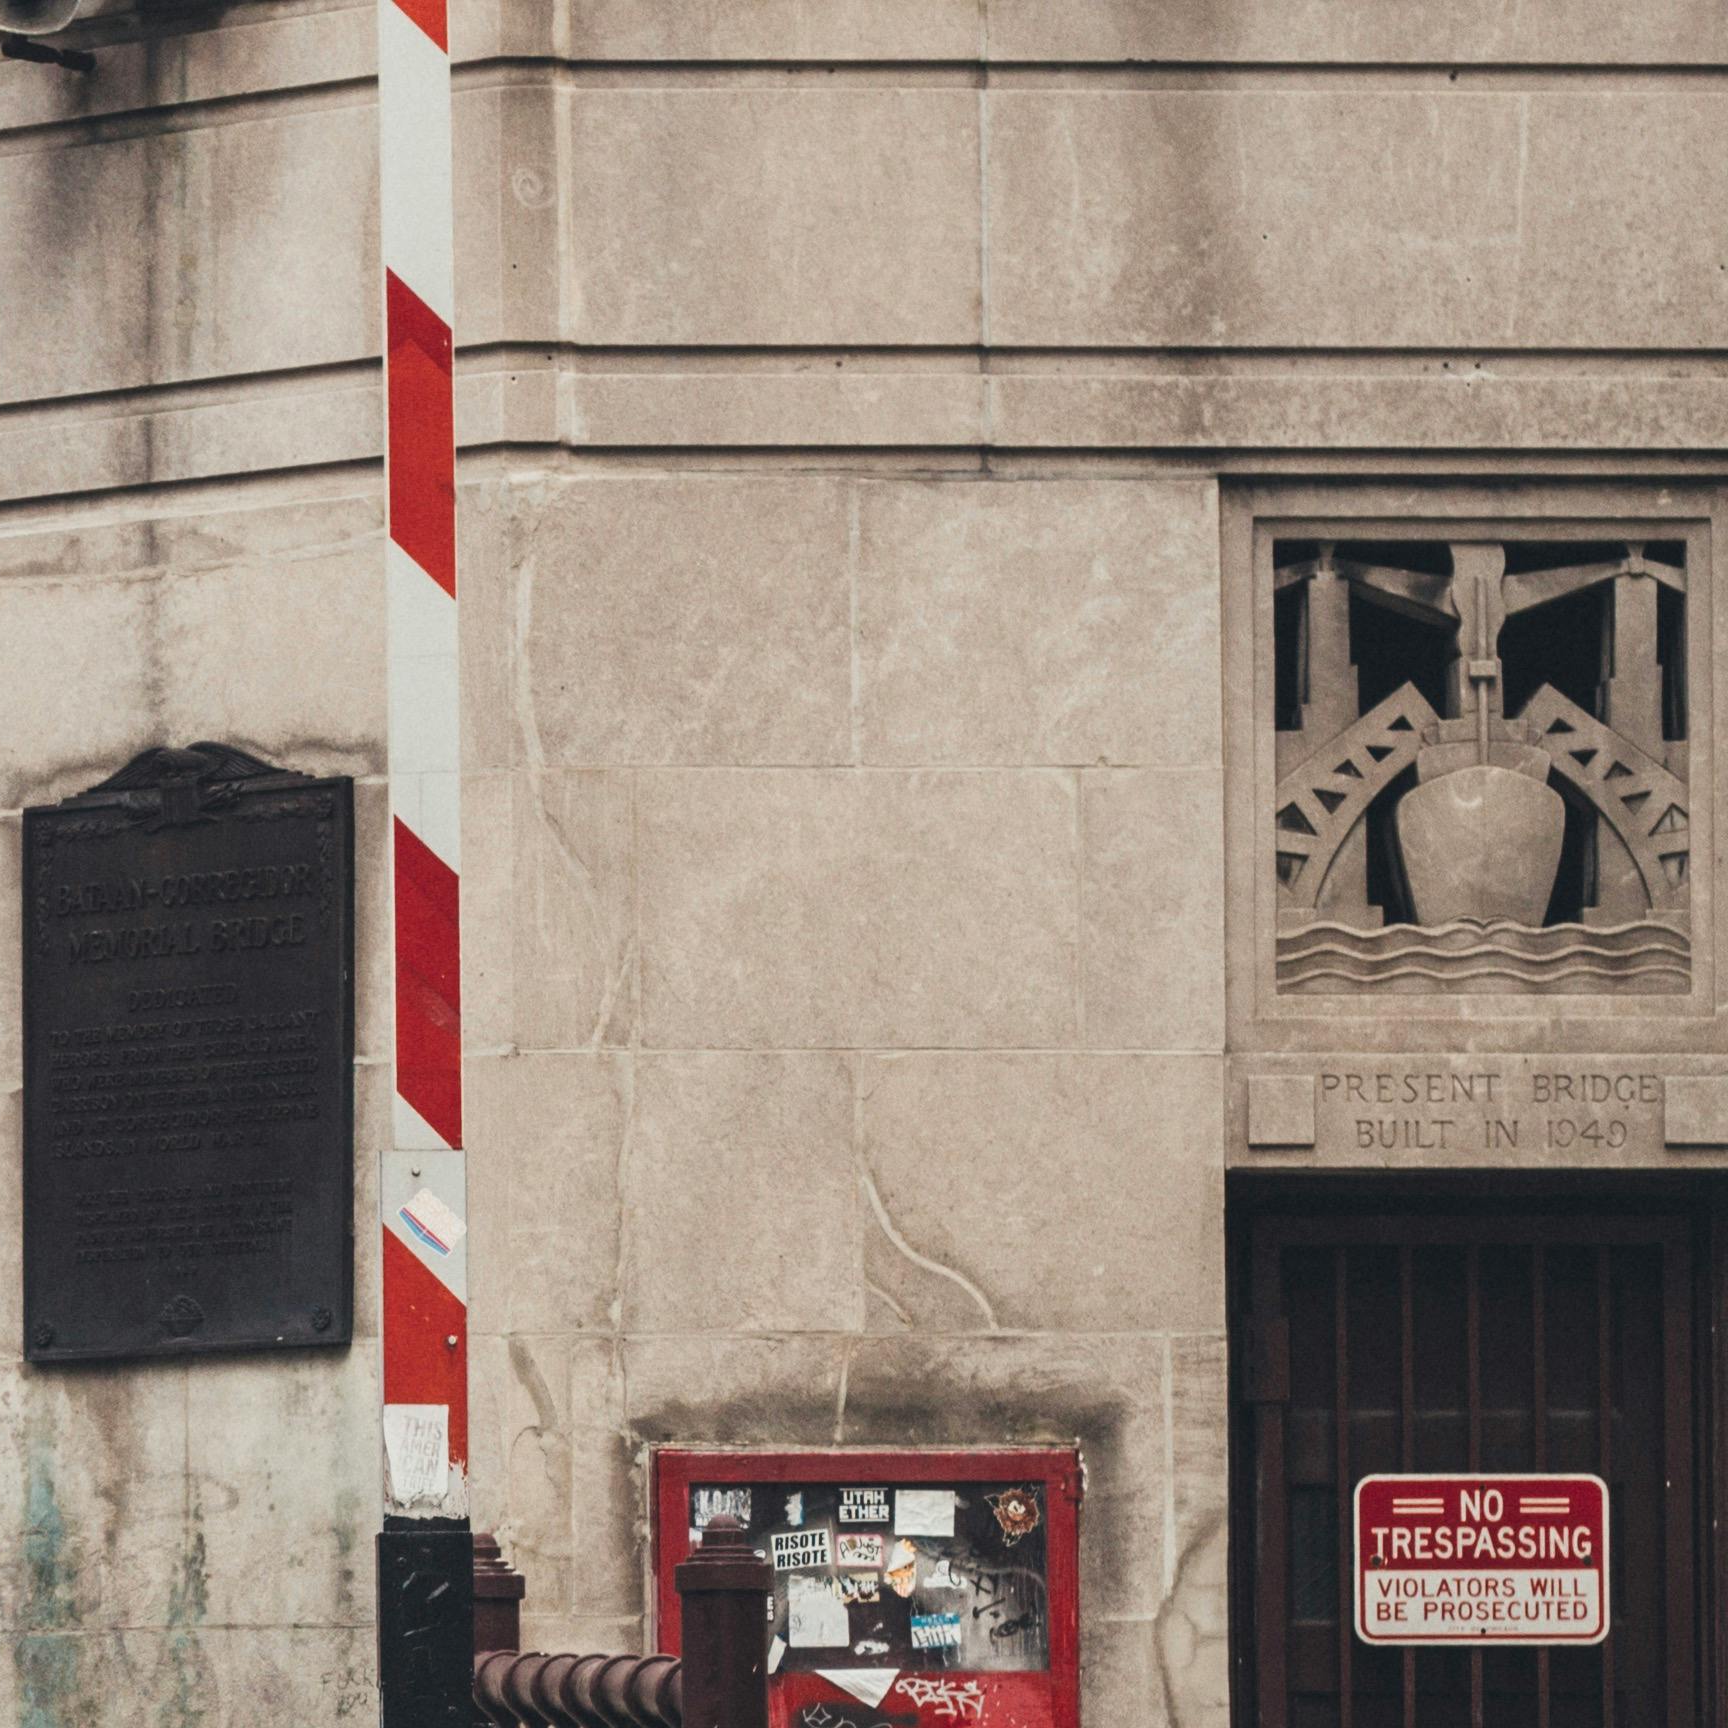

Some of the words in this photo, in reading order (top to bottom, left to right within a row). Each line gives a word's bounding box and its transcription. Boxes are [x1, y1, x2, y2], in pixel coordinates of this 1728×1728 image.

[211, 912, 307, 952] BRIDGE
[1321, 1074, 1501, 1104] PRESENT
[1532, 1074, 1660, 1104] BRIDGE
[1356, 1119, 1456, 1149] BUILT
[1485, 1119, 1519, 1148] IN
[1547, 1118, 1628, 1149] 1949
[843, 1491, 885, 1505] UTAH
[1460, 1489, 1503, 1522] NO
[839, 1505, 889, 1520] ETHER
[775, 1532, 826, 1551] RISOTE
[1371, 1526, 1593, 1559] TRESPASSING
[776, 1549, 828, 1568] RISOTE
[1378, 1578, 1515, 1598] VIOLATORS
[1530, 1578, 1587, 1598] WILL
[1377, 1601, 1407, 1621] BE
[1424, 1600, 1588, 1621] PROSECUTED
